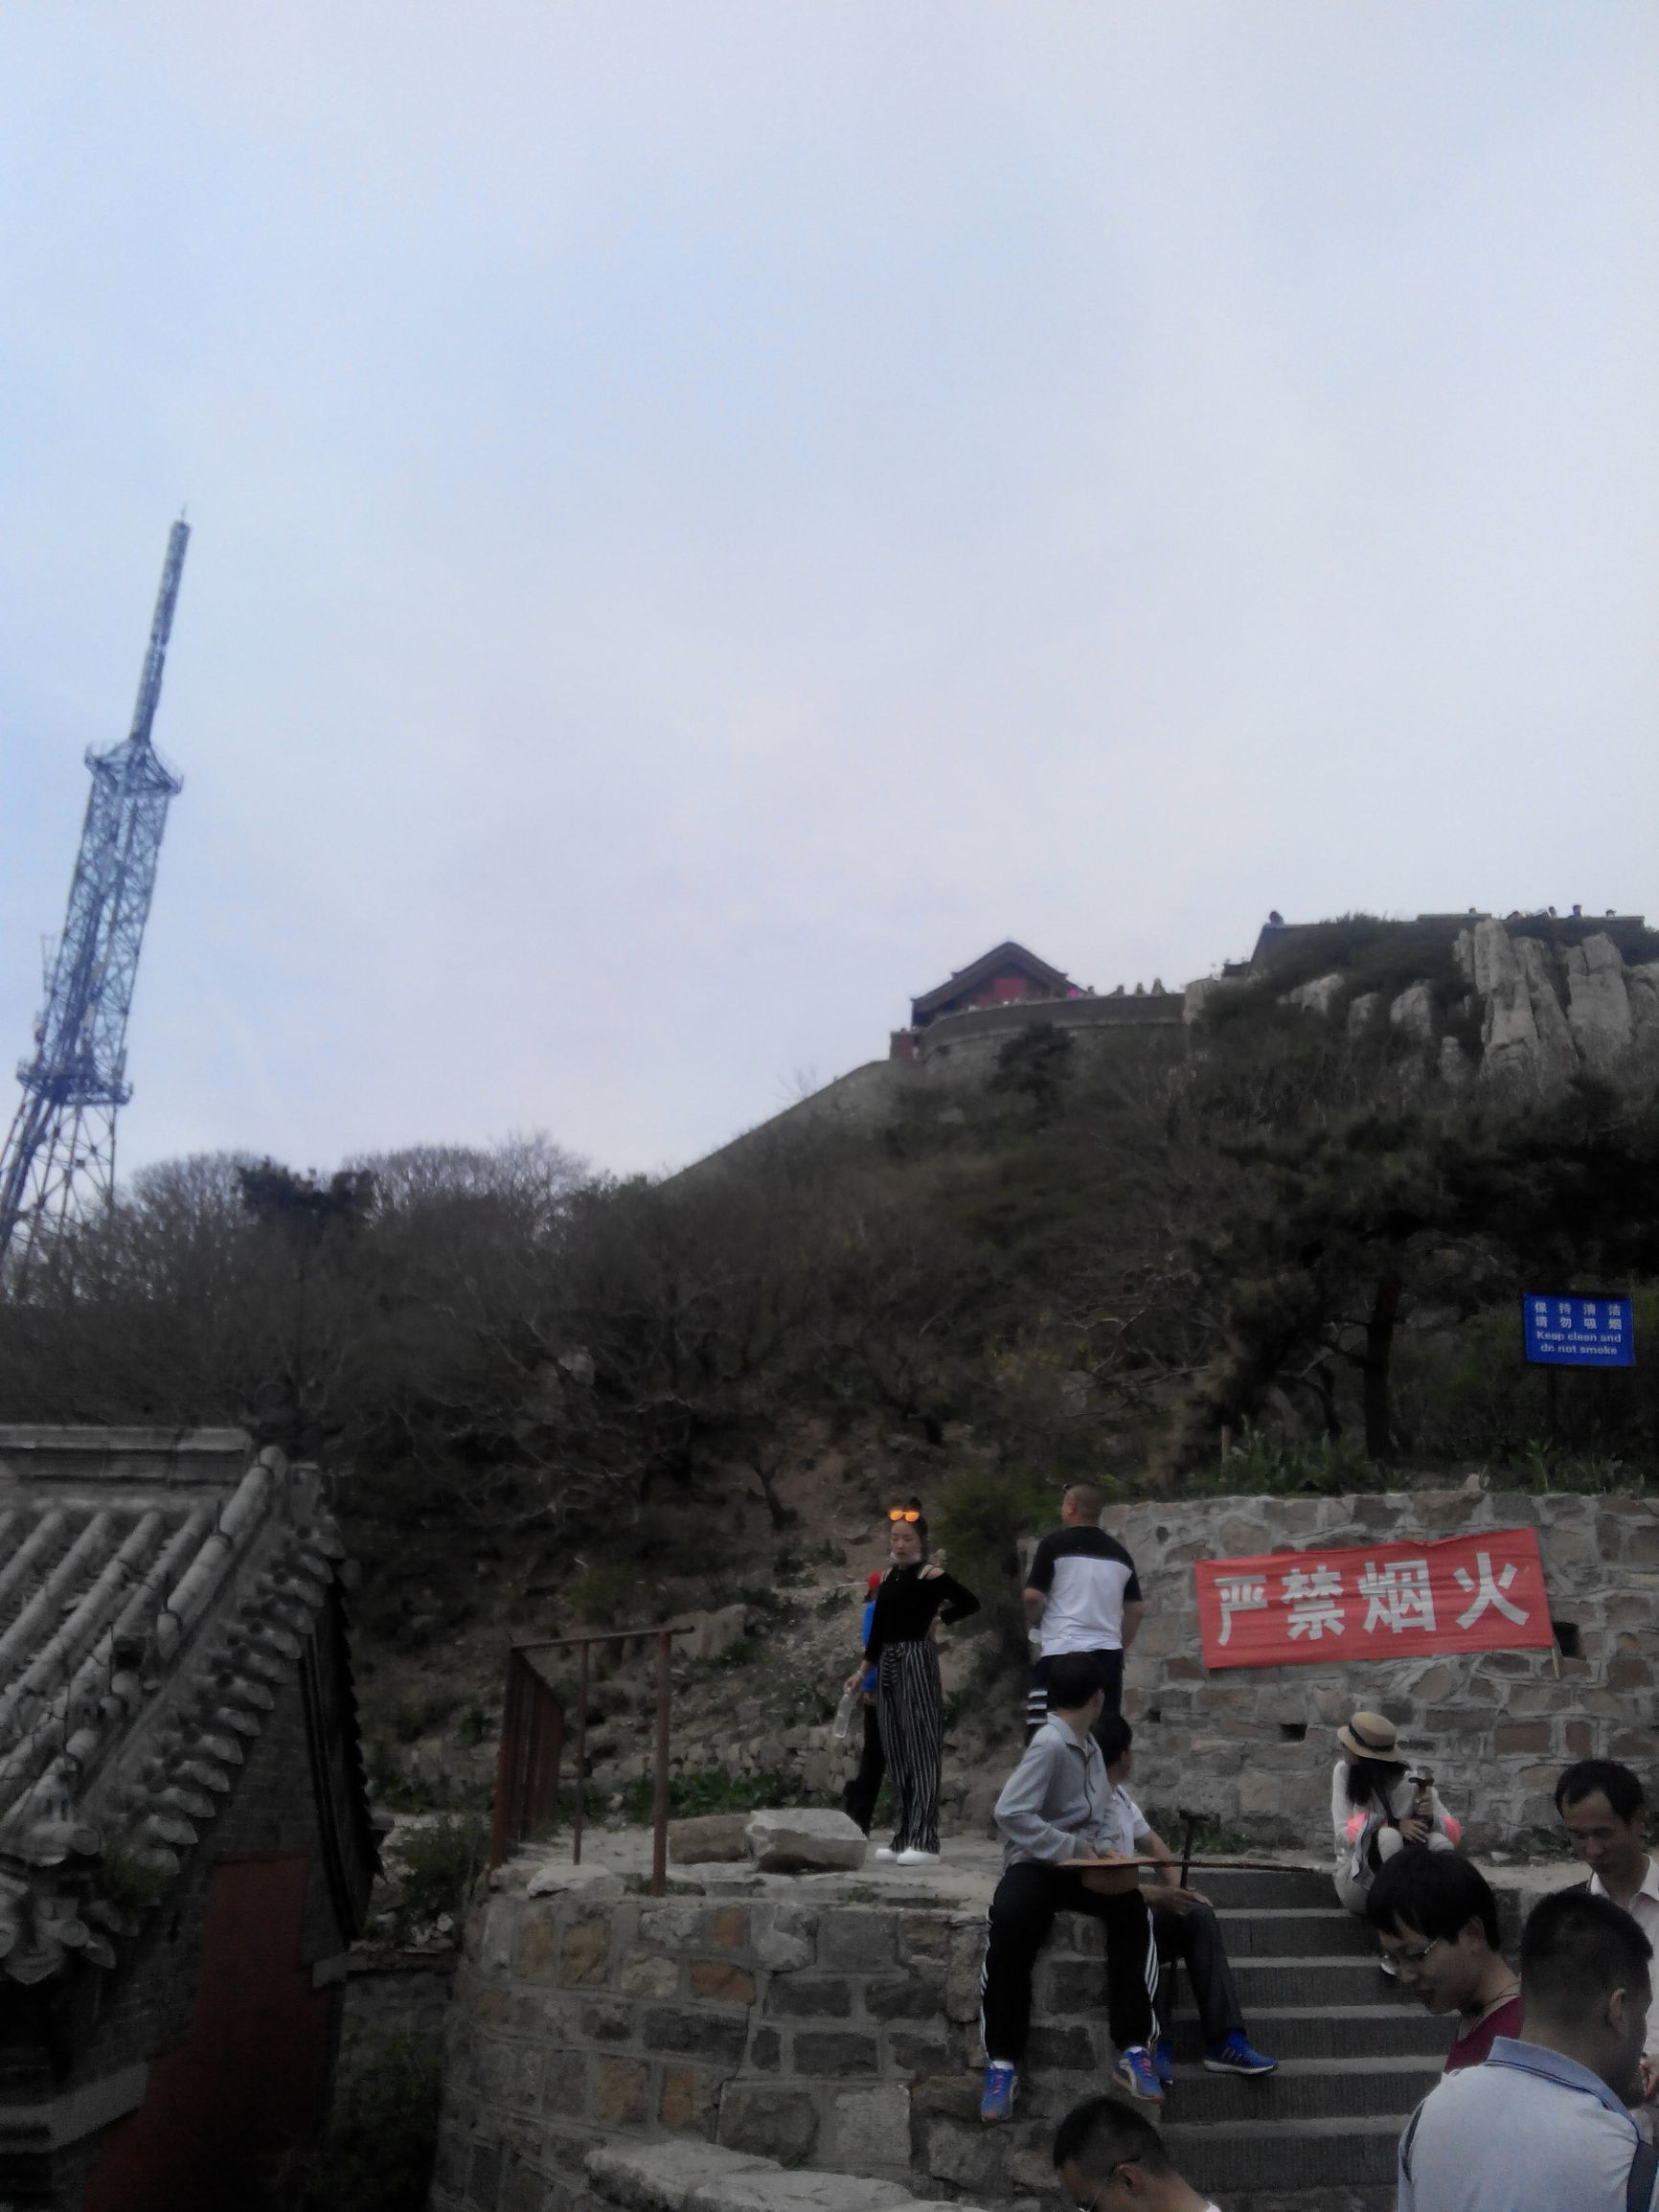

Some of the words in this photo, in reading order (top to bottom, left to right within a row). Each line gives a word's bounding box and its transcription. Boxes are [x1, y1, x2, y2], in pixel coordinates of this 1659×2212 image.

[1534, 1302, 1621, 1316] 保持清洁
[1535, 1316, 1623, 1331] 请勿吸烟
[1536, 1331, 1565, 1341] Keep
[1567, 1332, 1597, 1342] clean
[1601, 1333, 1622, 1343] and
[1540, 1343, 1555, 1353] do
[1557, 1344, 1577, 1354] not
[1579, 1345, 1618, 1356] smoke
[1215, 1552, 1531, 1647] 严禁烟火
